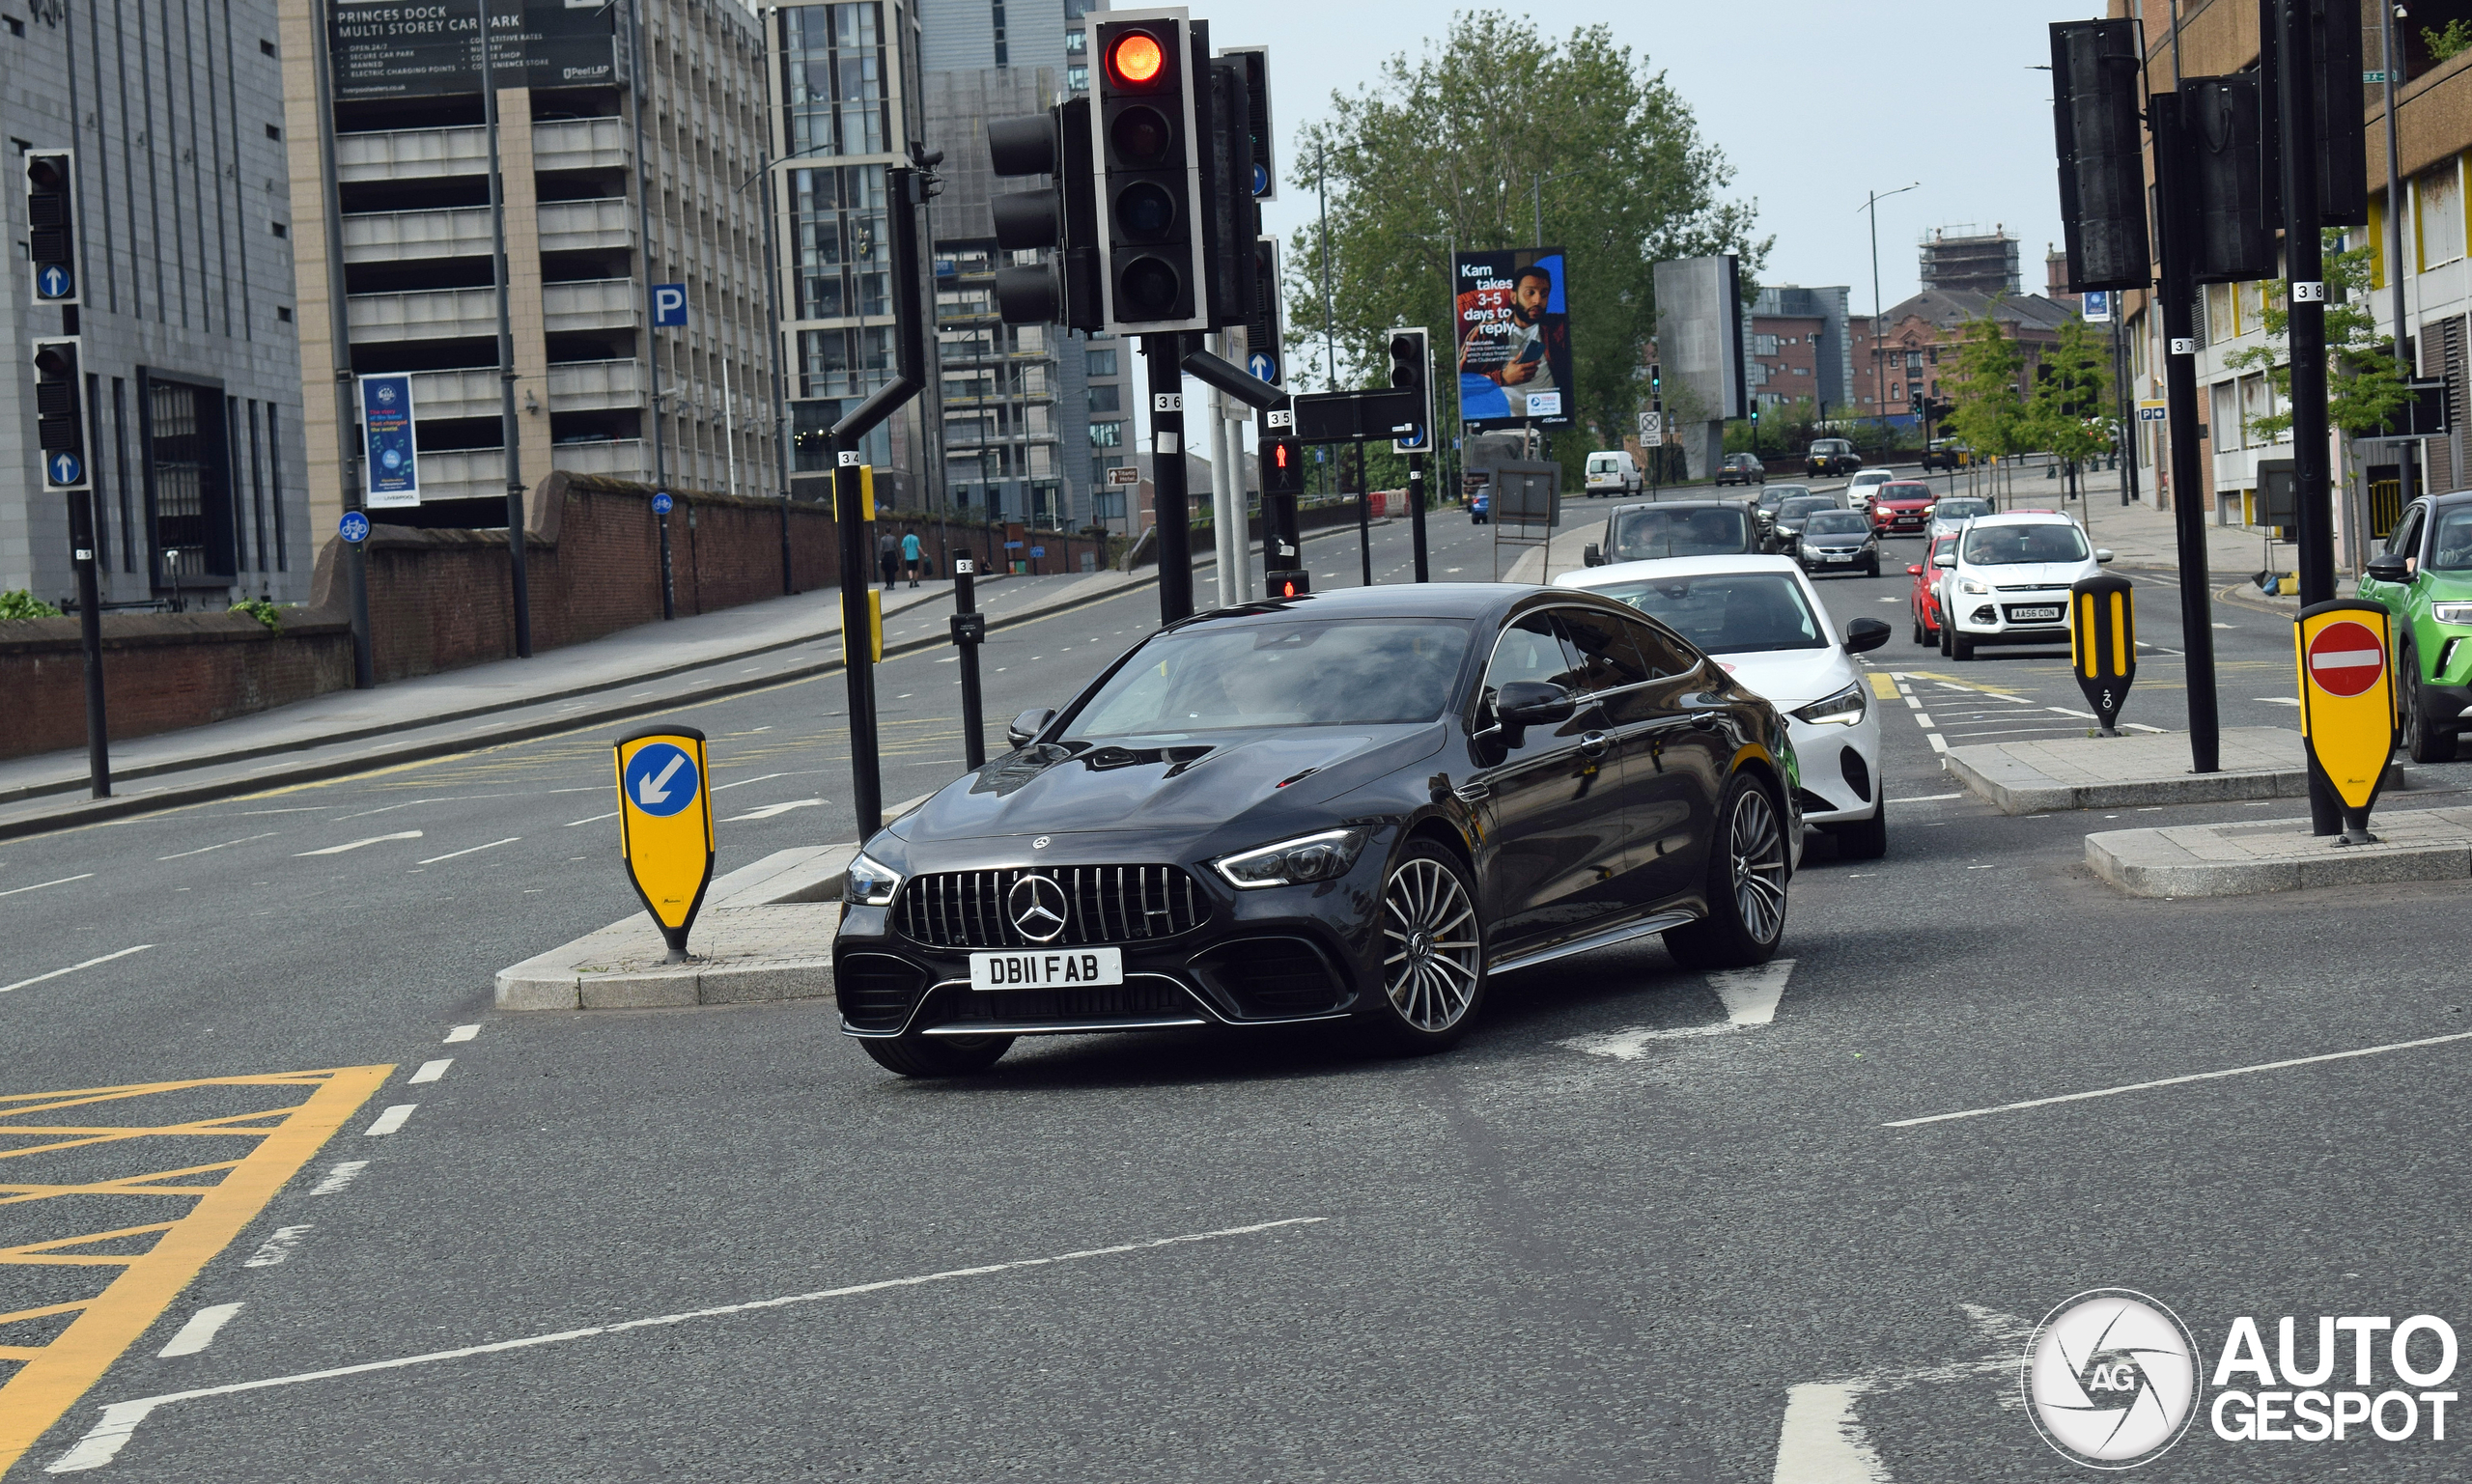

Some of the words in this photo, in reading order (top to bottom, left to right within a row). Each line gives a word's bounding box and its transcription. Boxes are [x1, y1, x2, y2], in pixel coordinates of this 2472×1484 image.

[338, 9, 399, 24] PRINCES
[405, 6, 446, 20] DOCK
[339, 24, 383, 38] MULTI
[388, 20, 444, 35] STOREY
[449, 17, 478, 31] CAR
[487, 14, 520, 28] ARK
[520, 33, 543, 42] RATES
[350, 50, 377, 60] SECURE
[379, 50, 394, 59] CAR
[396, 49, 415, 58] PARK
[500, 51, 520, 60] SHOP
[351, 61, 383, 70] MANNED
[525, 58, 549, 67] STORE
[351, 70, 384, 78] ELECTRIC
[386, 67, 426, 76] CHARGING
[428, 64, 456, 73] POINTS
[572, 67, 591, 76] Peel
[591, 65, 609, 74] L&P
[1461, 264, 1492, 278] Kam
[1475, 278, 1513, 291] takes
[2298, 285, 2322, 298] 38
[1477, 292, 1502, 305] 3-5
[657, 289, 683, 322] P
[1463, 308, 1495, 322] days
[1497, 306, 1512, 318] to
[2175, 341, 2194, 351] 37
[1158, 396, 1181, 408] 36
[1271, 412, 1290, 425] 35
[842, 453, 859, 463] 34
[2015, 609, 2037, 618] AA56
[2038, 608, 2055, 617] CON
[1044, 954, 1099, 983] FAB
